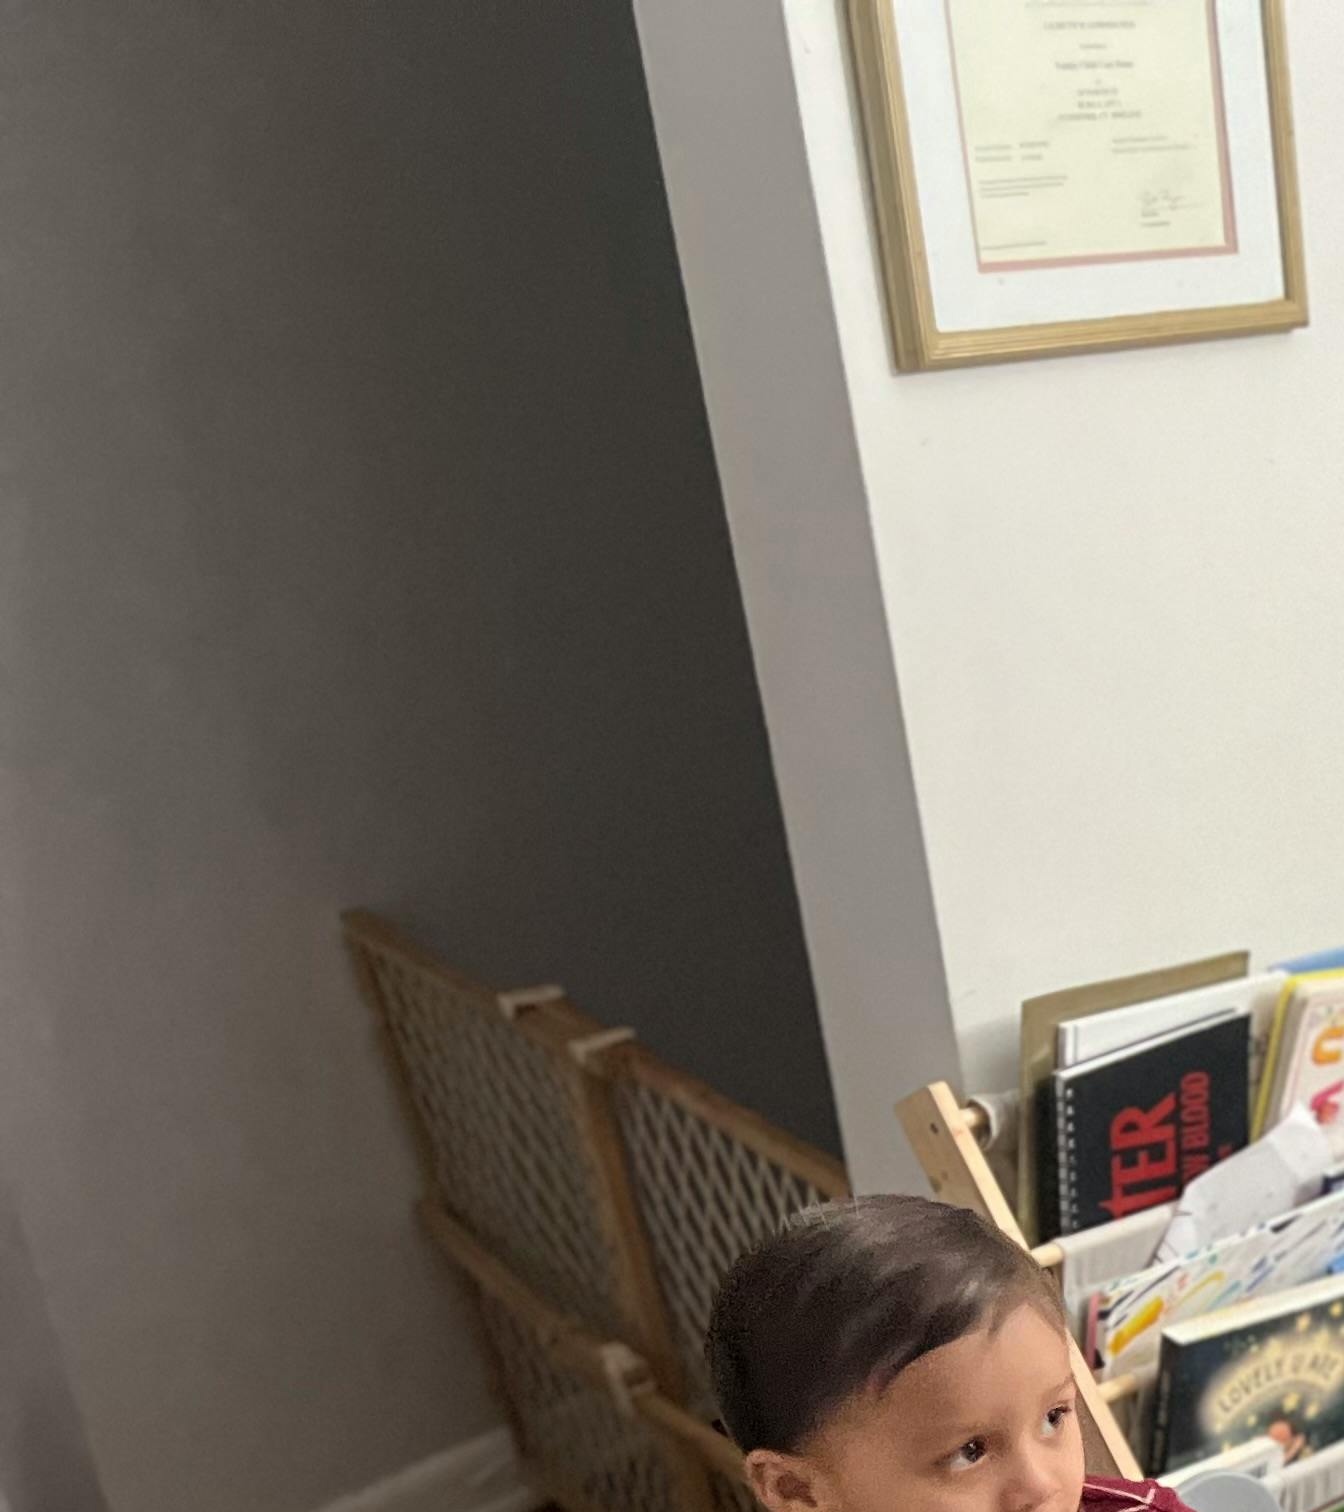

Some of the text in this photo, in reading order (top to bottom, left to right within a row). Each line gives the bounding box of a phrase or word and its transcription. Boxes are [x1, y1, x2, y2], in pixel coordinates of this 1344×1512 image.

[1181, 1071, 1211, 1150] BLOOD
[1098, 1092, 1178, 1221] TER
[1218, 1358, 1284, 1413] LOVELY
